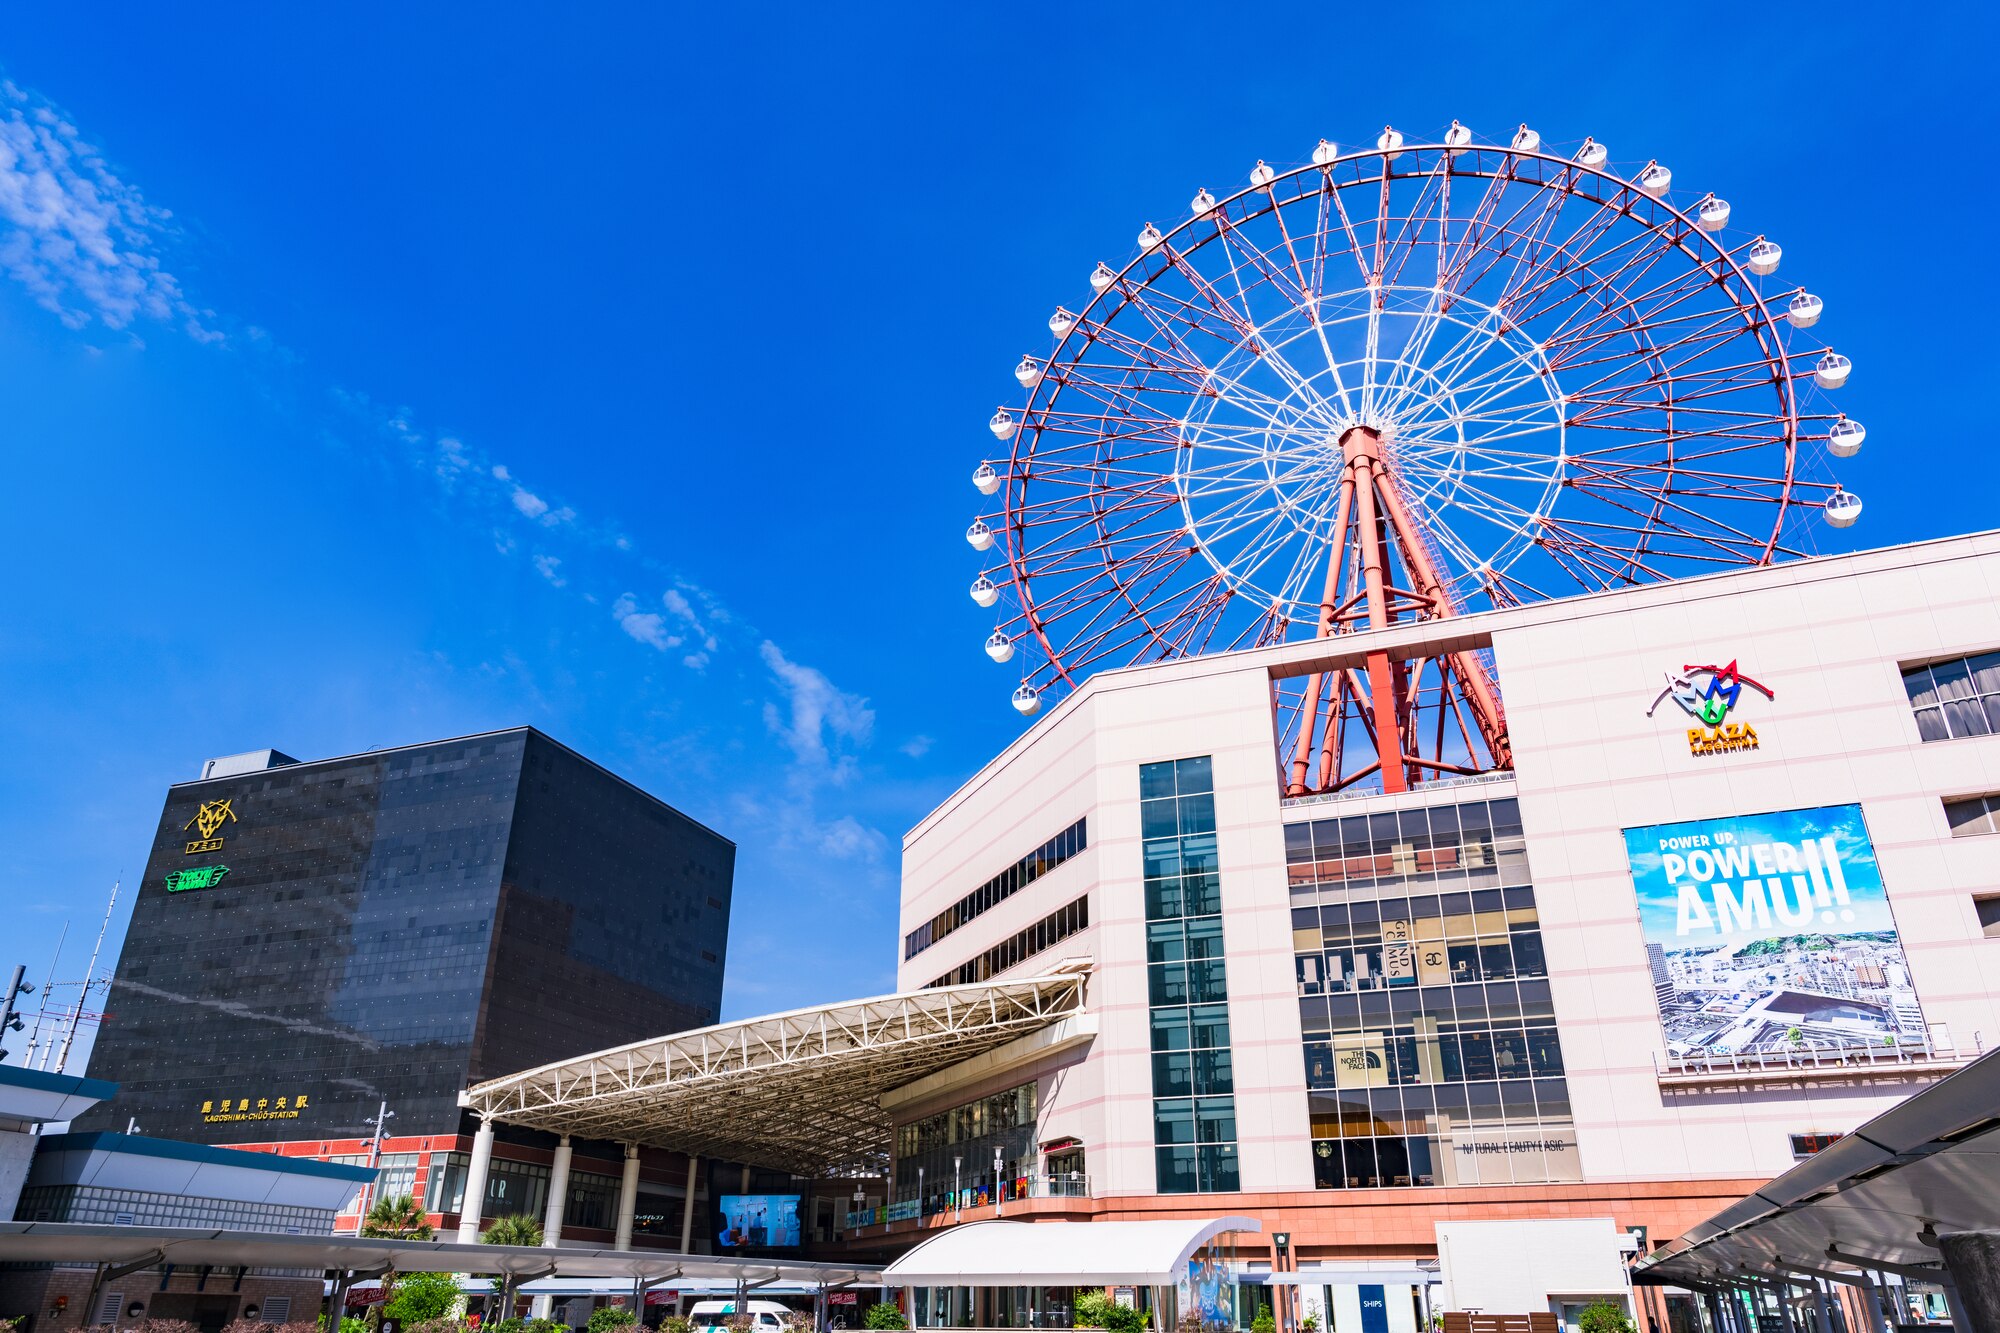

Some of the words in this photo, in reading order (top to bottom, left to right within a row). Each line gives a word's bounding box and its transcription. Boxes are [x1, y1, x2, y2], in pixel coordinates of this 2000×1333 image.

[1686, 722, 1758, 744] PLAZA
[1690, 738, 1760, 754] KAGOSHIMA
[1659, 834, 1710, 851] POWER
[1714, 832, 1738, 846] UP,
[1662, 842, 1803, 884] POWER
[201, 1095, 309, 1114] 鹿児島中央駅
[269, 1110, 299, 1119] STATION
[1363, 1300, 1383, 1308] SHIPS
